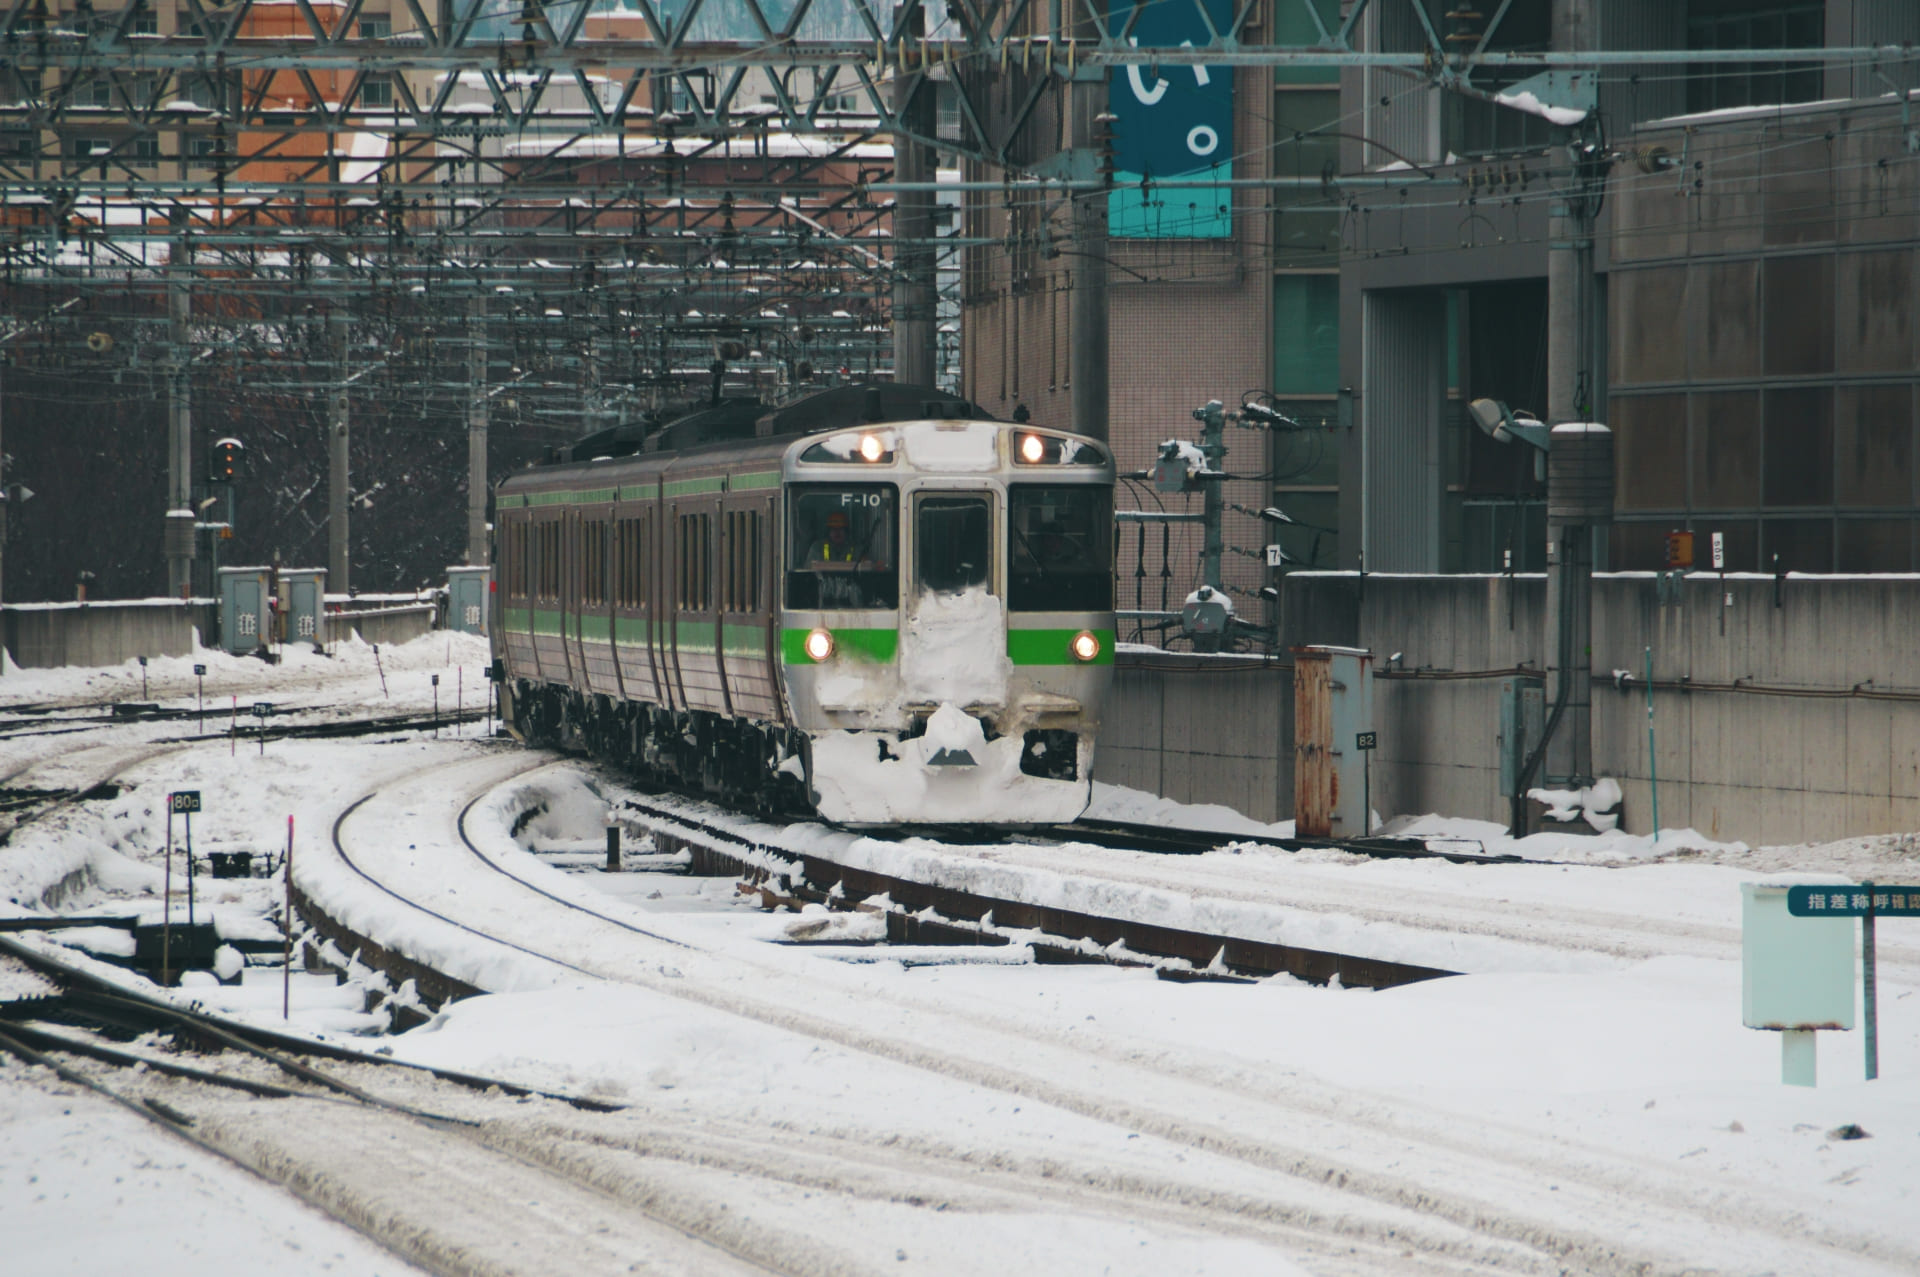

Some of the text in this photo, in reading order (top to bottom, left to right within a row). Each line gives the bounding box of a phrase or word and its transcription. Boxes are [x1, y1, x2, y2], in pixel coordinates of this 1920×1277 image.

[841, 493, 880, 507] F-10
[1269, 549, 1277, 563] 7
[1359, 735, 1374, 746] 82
